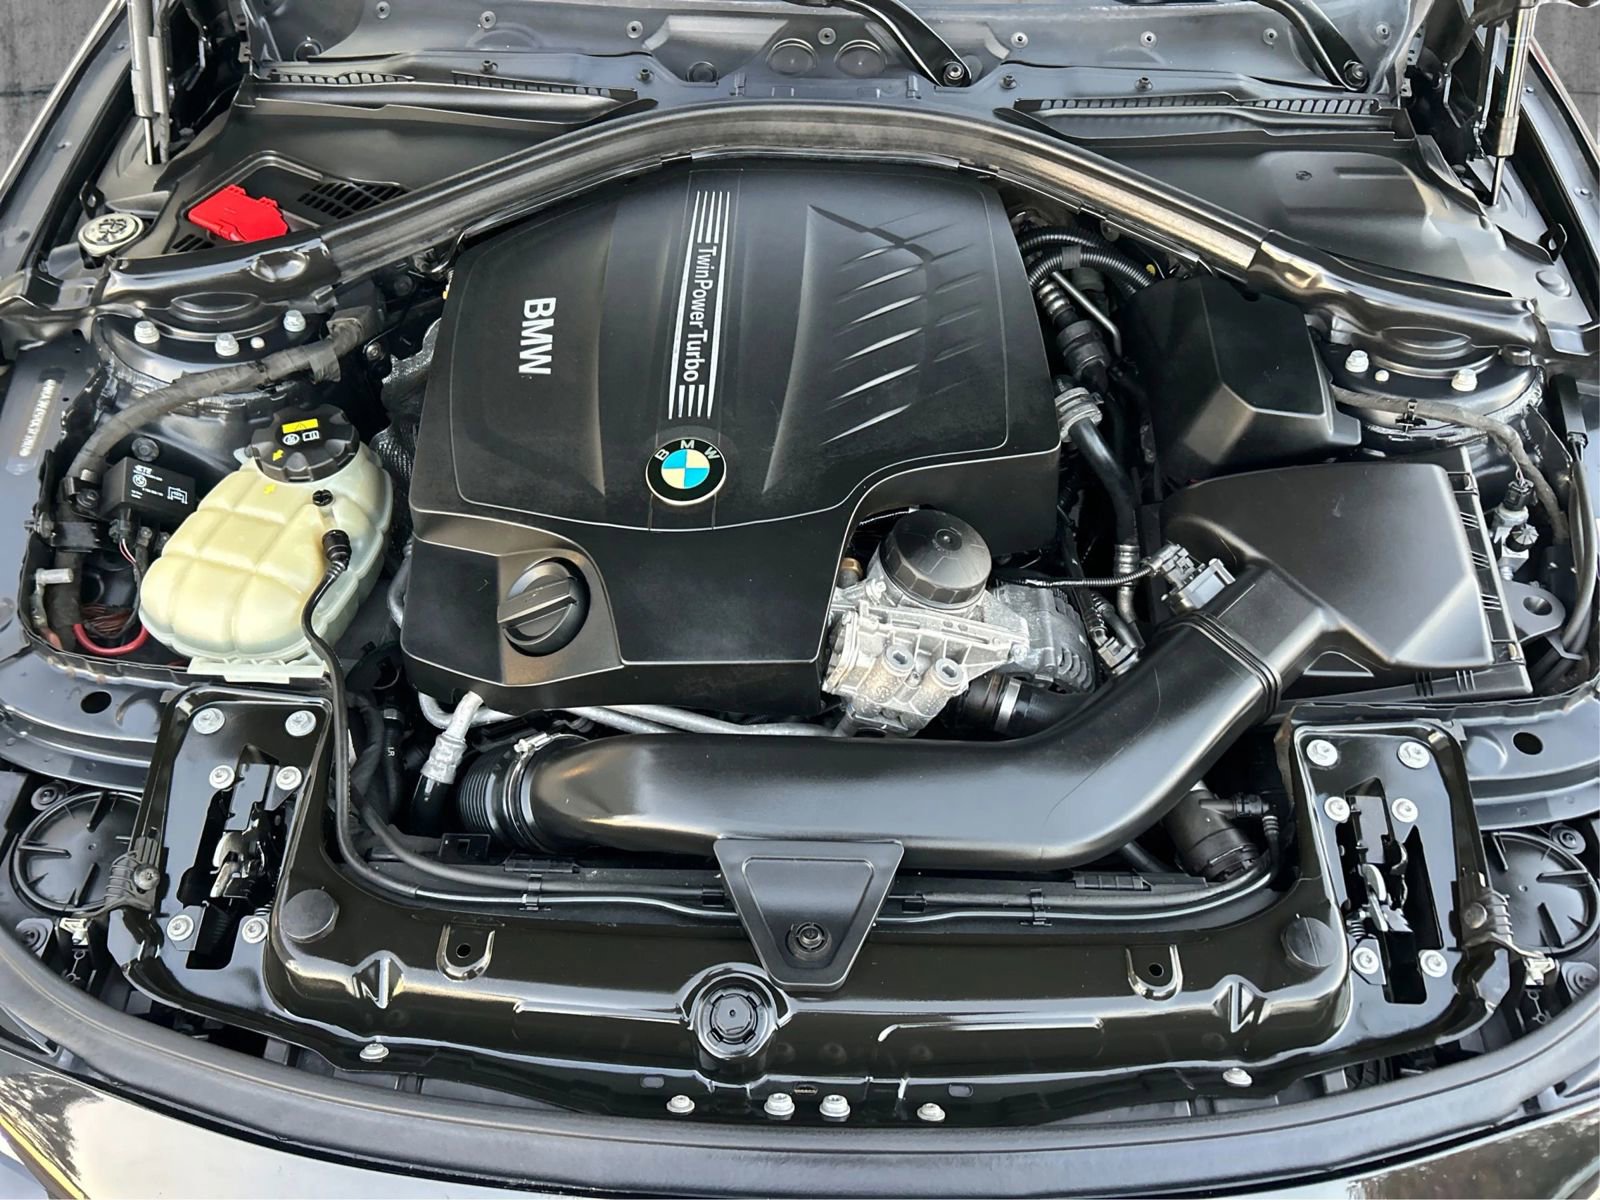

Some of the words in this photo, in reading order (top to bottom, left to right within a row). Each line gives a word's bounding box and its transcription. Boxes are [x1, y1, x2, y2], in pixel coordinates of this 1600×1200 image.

[689, 245, 717, 328] TwinPower
[518, 297, 557, 375] BMW
[683, 329, 708, 382] Turbo
[654, 439, 720, 461] BMW
